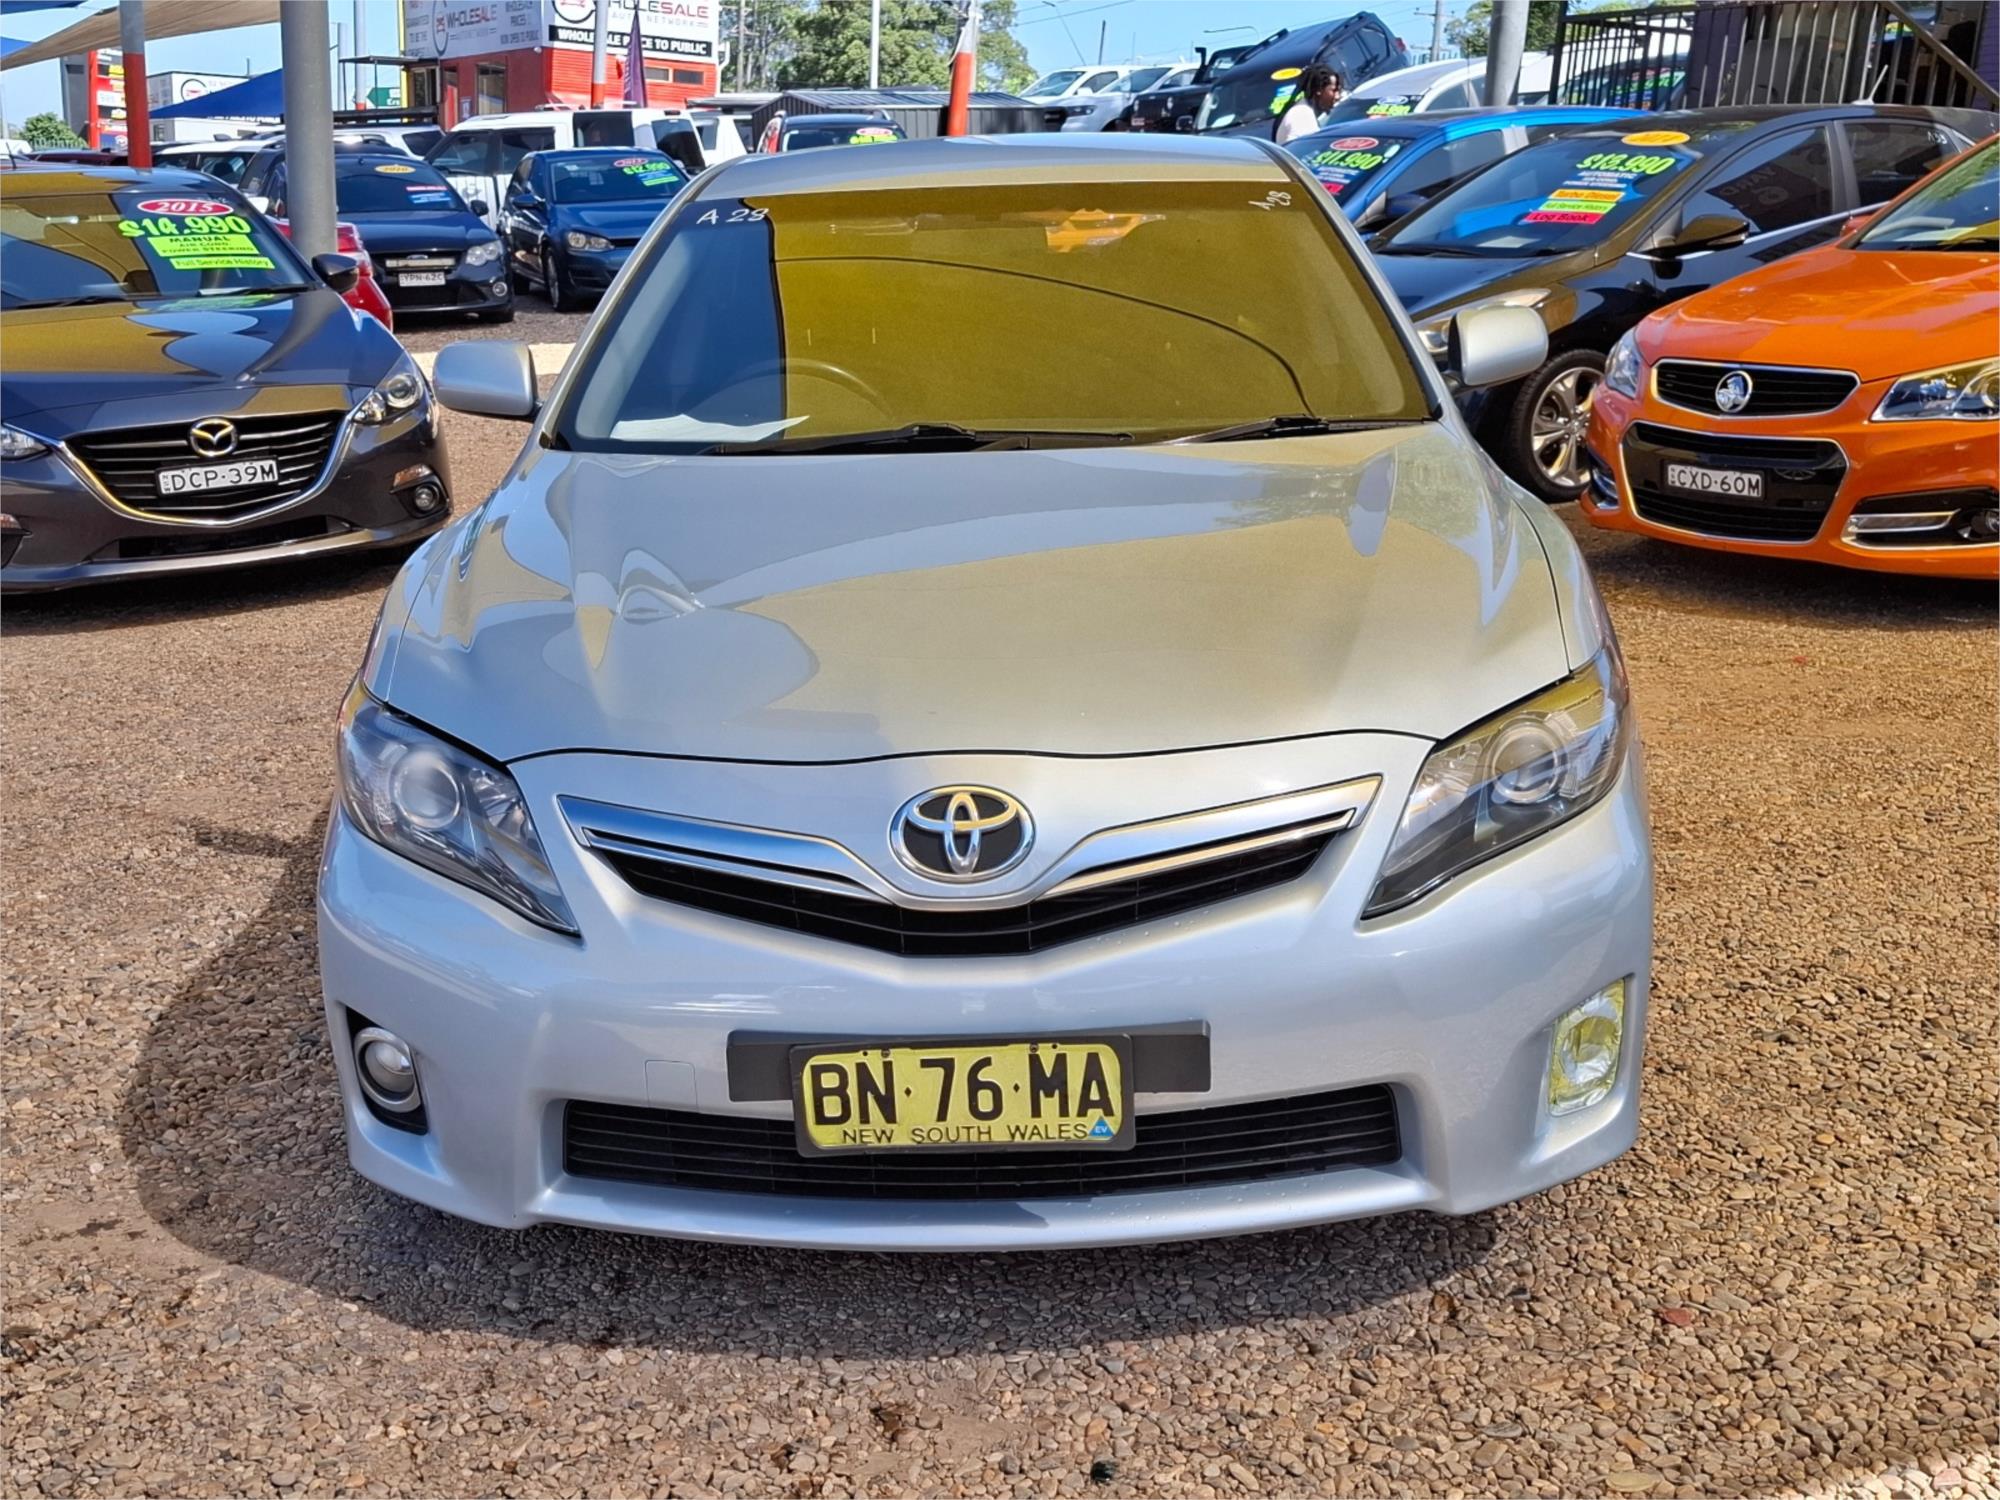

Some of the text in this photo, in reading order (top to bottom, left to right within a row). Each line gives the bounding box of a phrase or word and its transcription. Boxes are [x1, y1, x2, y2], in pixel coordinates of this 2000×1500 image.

[608, 0, 709, 18] HOLESALE
[557, 29, 707, 54] WHOLELE PCE TO PUBLIC
[156, 202, 213, 213] 2015
[118, 216, 251, 237] $14.990
[1533, 213, 1590, 222] Log Book
[842, 1123, 1088, 1144] NEW SOUTH WALES
